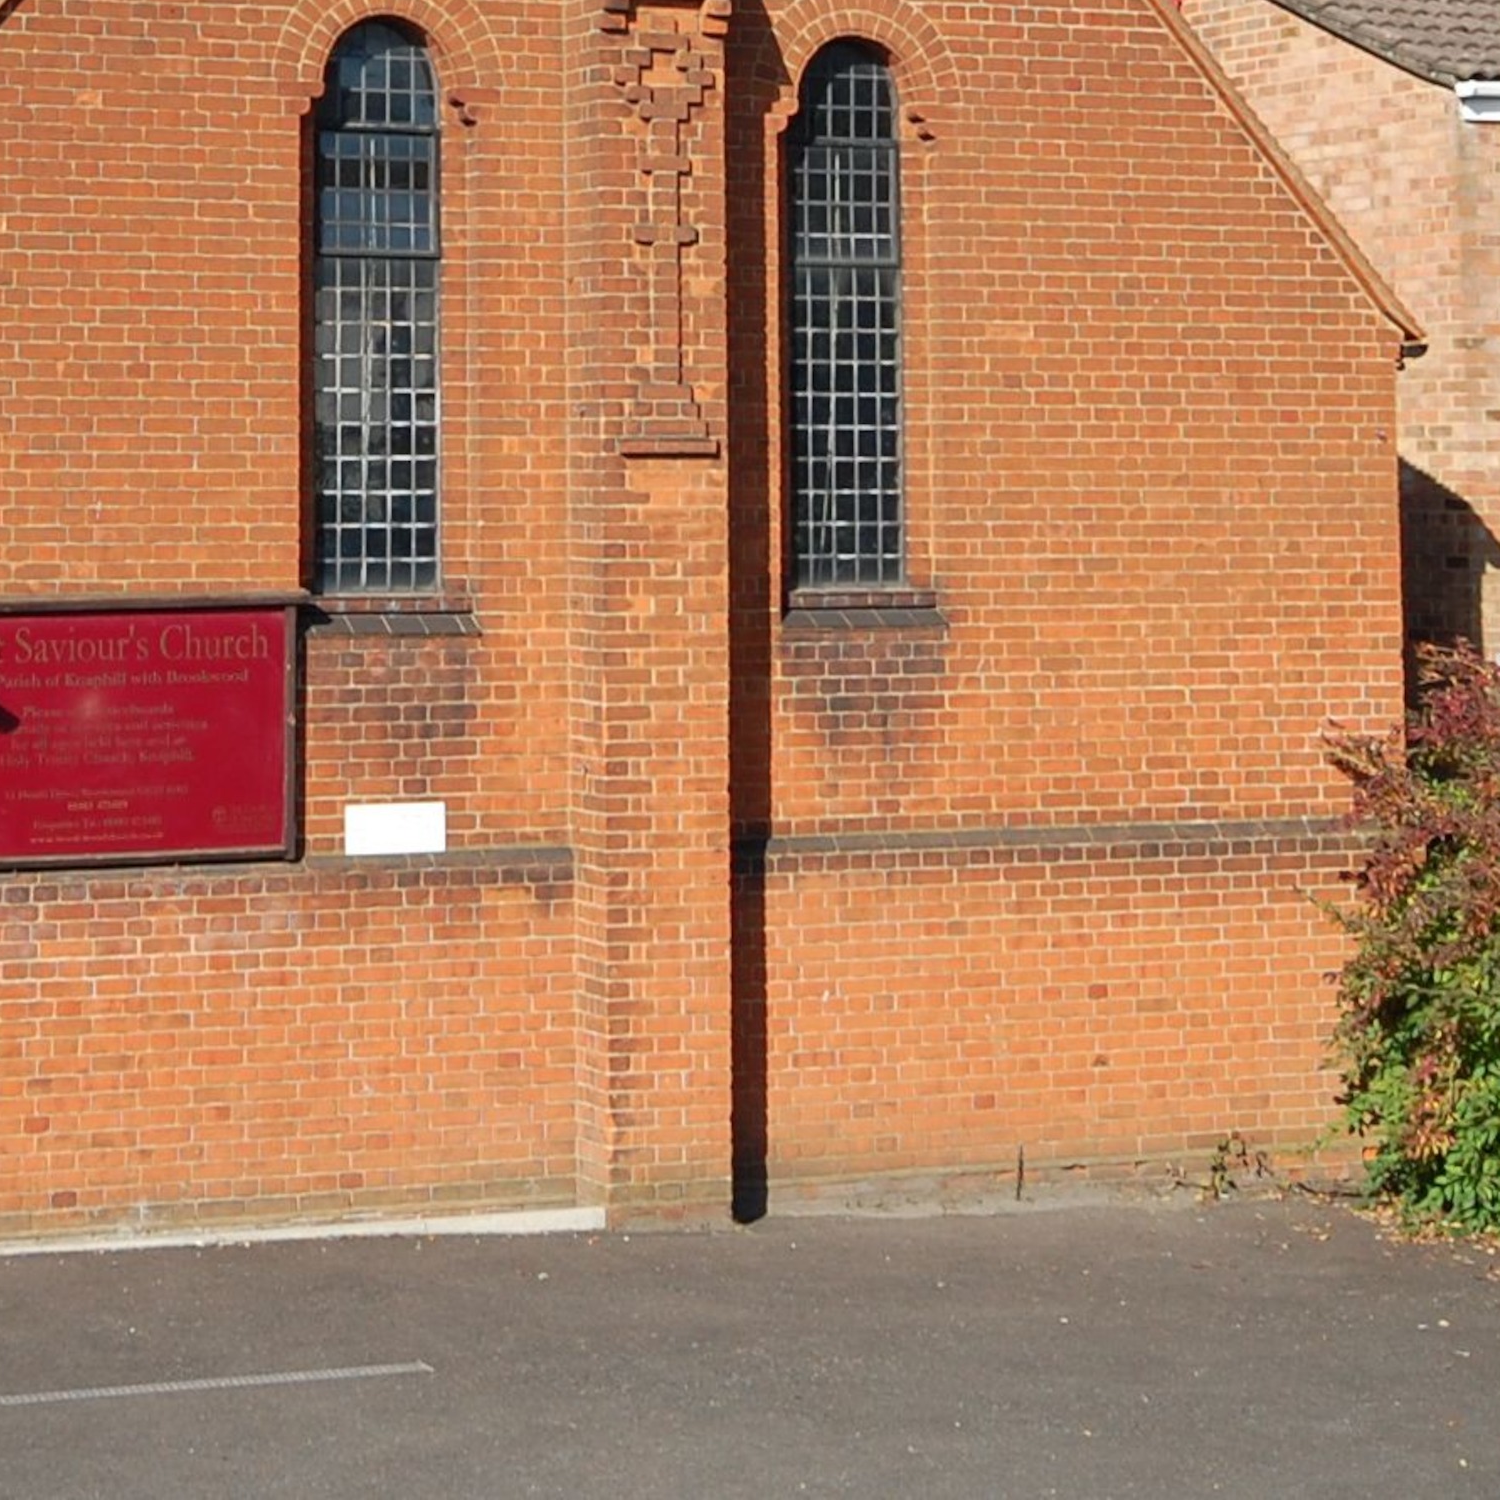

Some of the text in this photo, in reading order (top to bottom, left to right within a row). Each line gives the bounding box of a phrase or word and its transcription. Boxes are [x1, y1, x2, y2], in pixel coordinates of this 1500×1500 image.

[15, 623, 149, 664] Saviour's
[159, 623, 269, 660] Church
[44, 673, 60, 688] of
[131, 670, 162, 684] with
